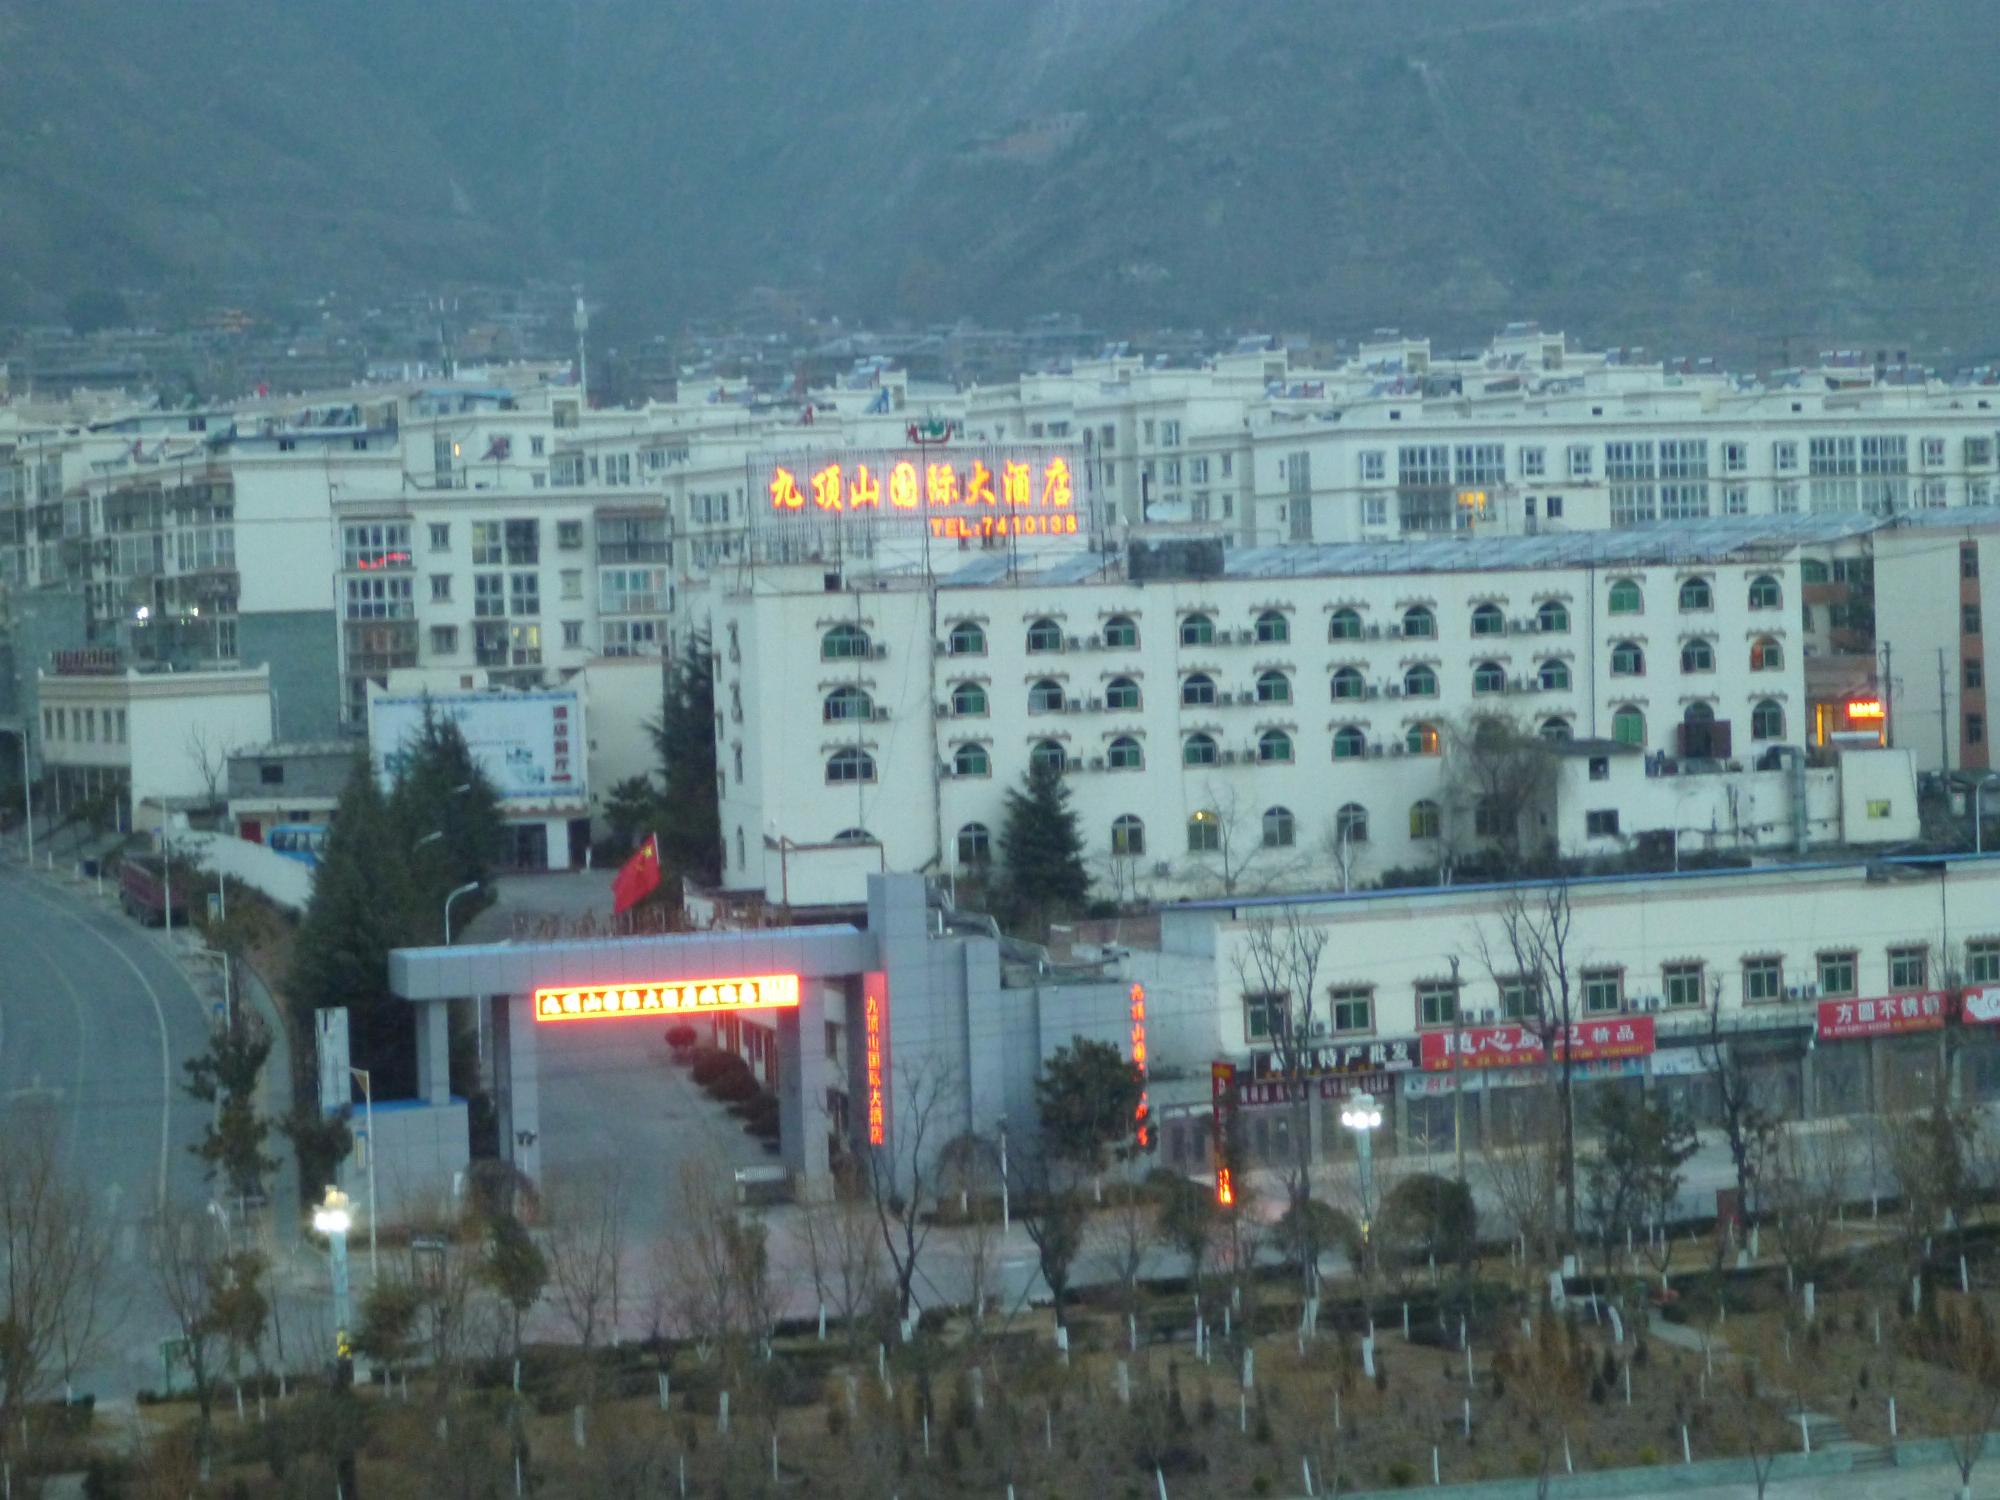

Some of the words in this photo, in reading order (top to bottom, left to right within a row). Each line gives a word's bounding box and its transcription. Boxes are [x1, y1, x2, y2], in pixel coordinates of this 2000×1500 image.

[769, 457, 1073, 510] 九顶山国际大酒店
